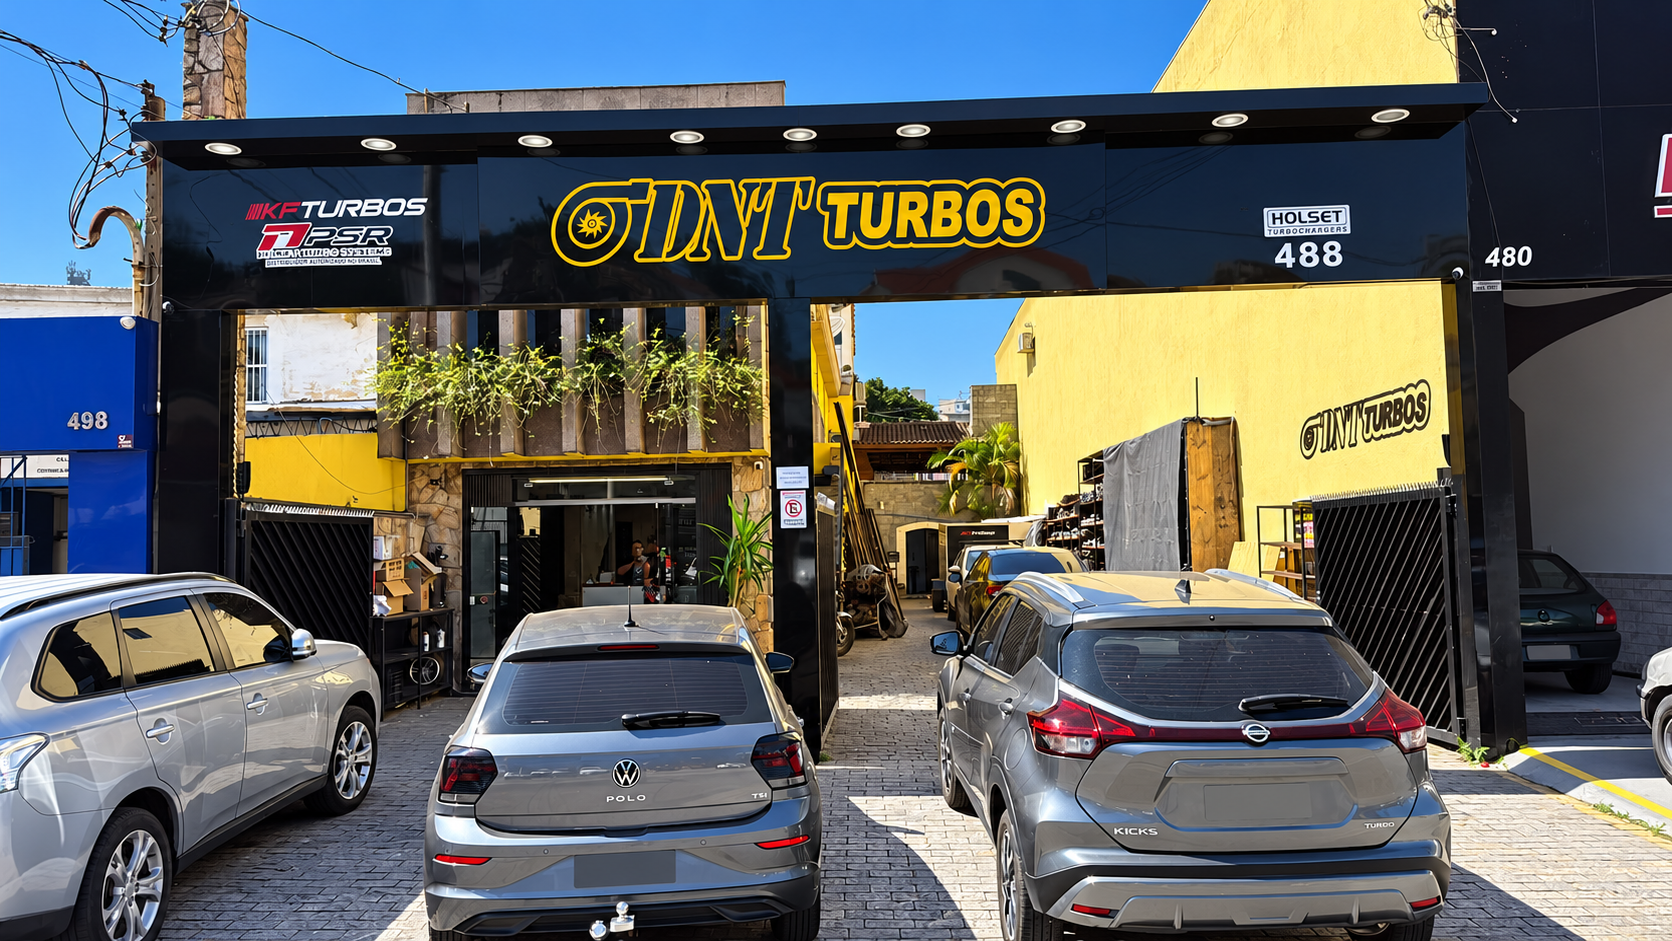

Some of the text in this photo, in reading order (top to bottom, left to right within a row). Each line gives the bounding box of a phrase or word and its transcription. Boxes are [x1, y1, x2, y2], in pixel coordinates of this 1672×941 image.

[634, 177, 1035, 263] DNT TURBOS
[1271, 210, 1343, 225] HOLSET
[1267, 226, 1348, 236] TURBOCHARGERS
[1274, 240, 1343, 269] 488
[1484, 245, 1533, 267] 480
[67, 410, 108, 431] 498
[1364, 391, 1427, 435] TURBOS
[606, 794, 646, 803] POLO
[1113, 827, 1158, 836] KICKS
